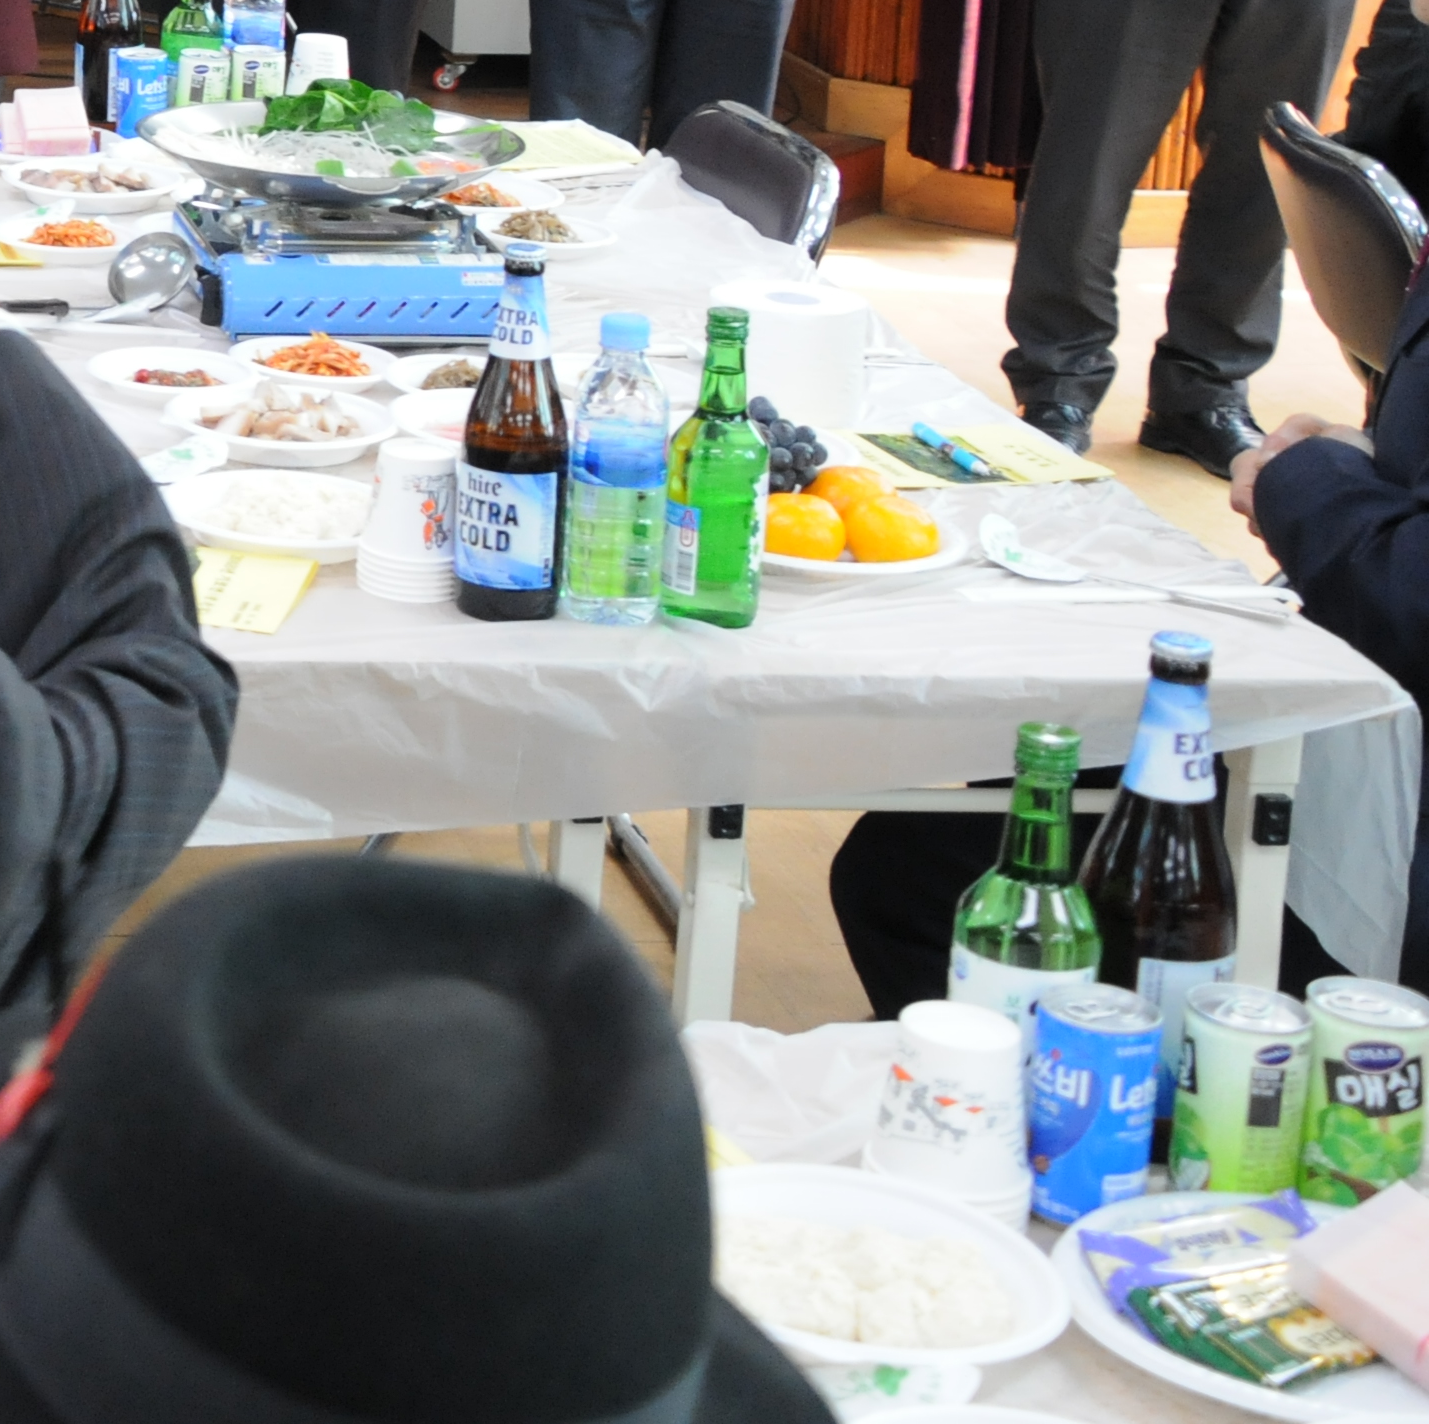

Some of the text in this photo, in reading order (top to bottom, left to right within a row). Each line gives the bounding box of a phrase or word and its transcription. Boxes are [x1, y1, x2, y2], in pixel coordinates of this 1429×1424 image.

[467, 472, 503, 498] hite
[458, 491, 519, 527] EXTRA
[460, 520, 511, 553] COLD
